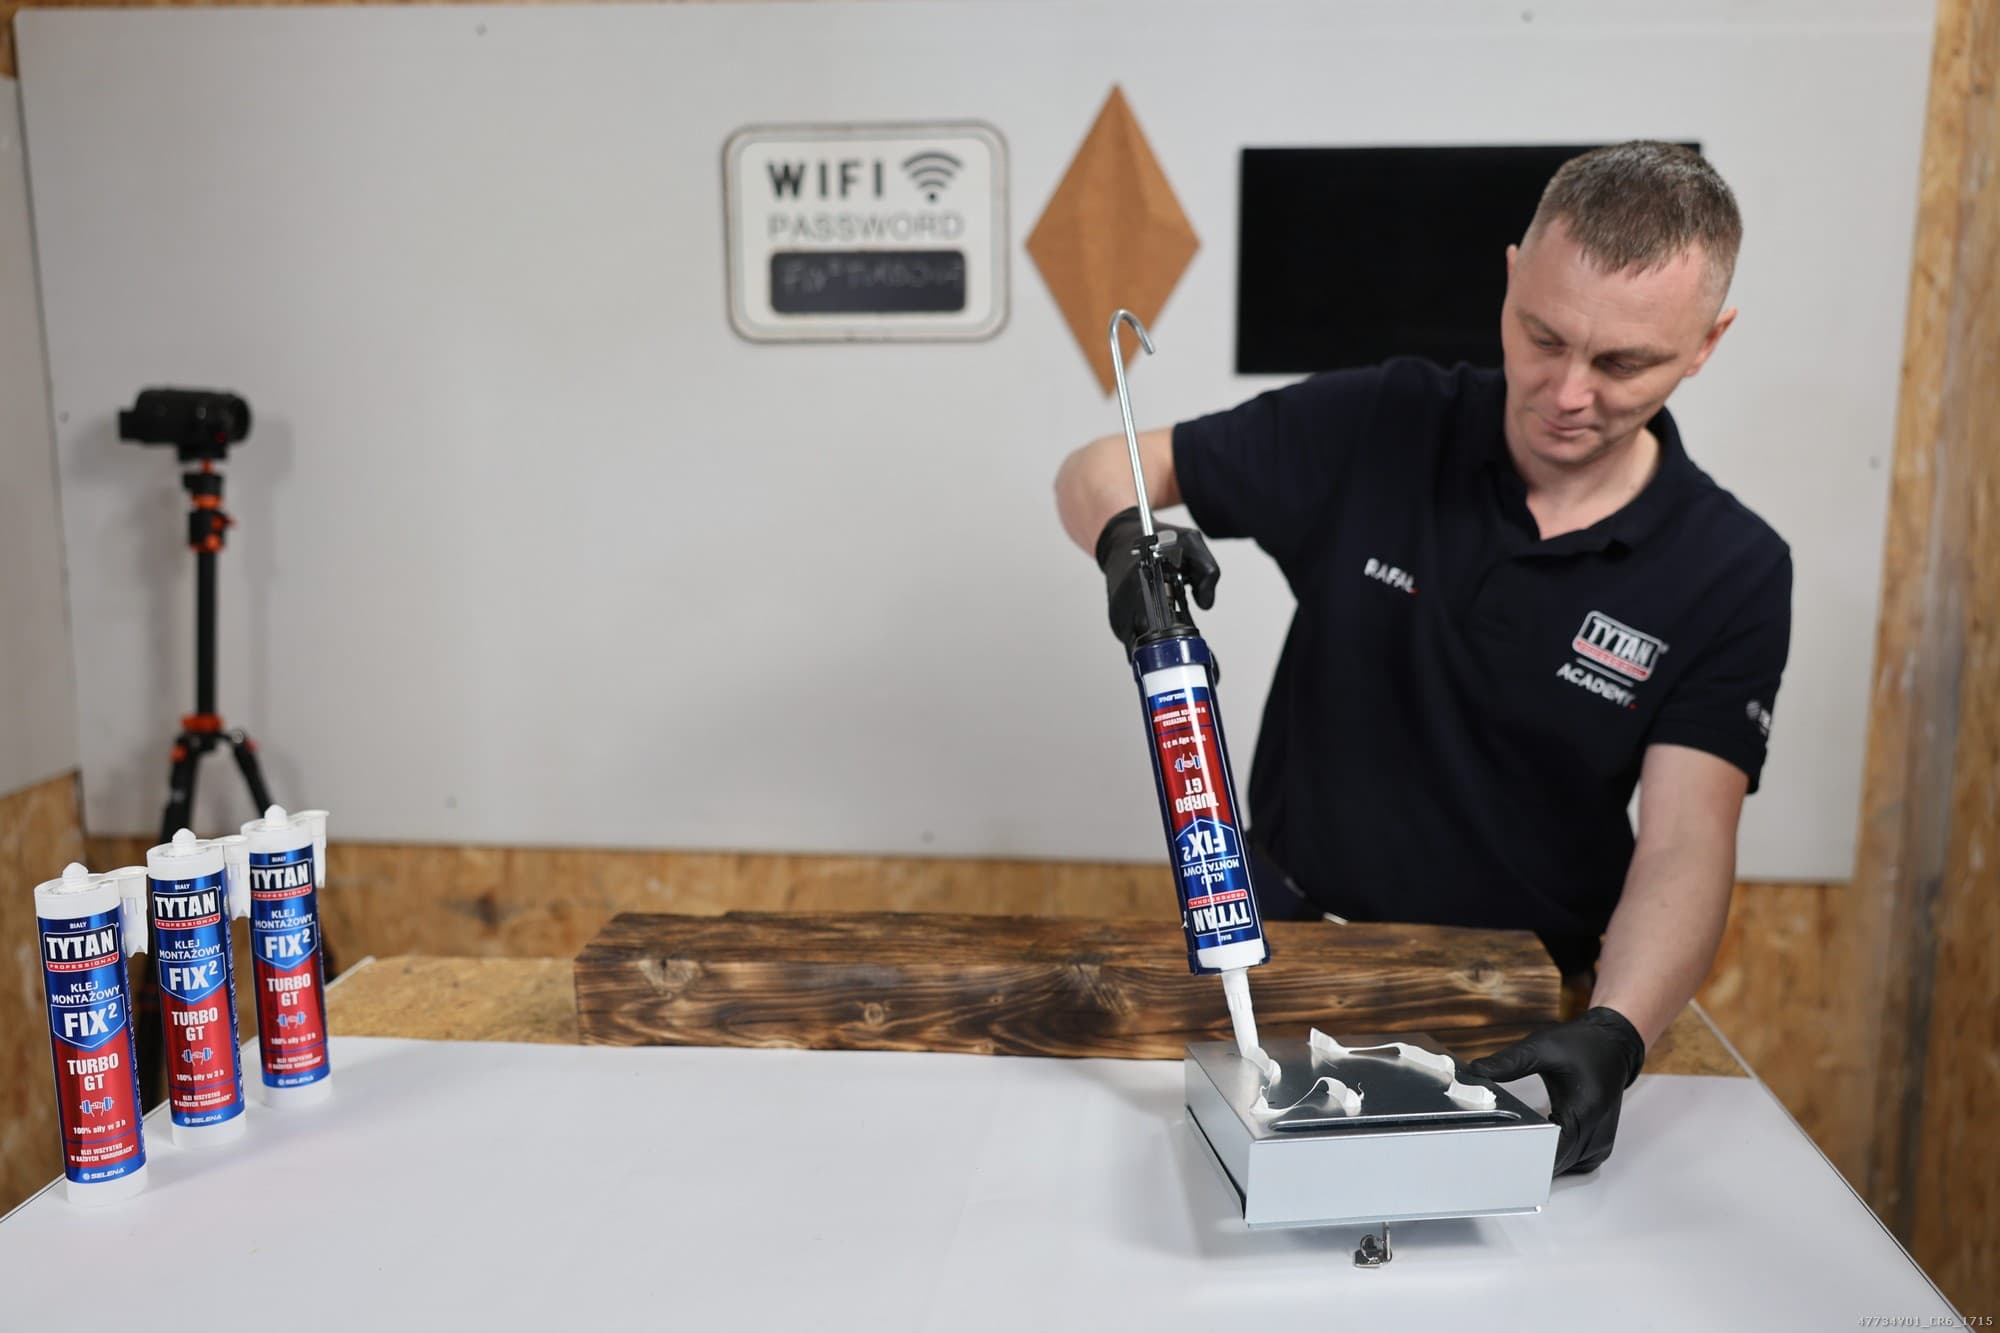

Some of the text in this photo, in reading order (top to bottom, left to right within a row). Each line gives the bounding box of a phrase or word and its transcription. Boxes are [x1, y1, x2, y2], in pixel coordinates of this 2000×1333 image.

[767, 160, 883, 199] WIFI
[768, 210, 966, 240] PASSWORD
[1587, 618, 1655, 667] TYTAN
[1184, 777, 1202, 795] GT
[1175, 791, 1219, 813] TURBO
[251, 863, 309, 890] TYTAN
[155, 892, 216, 918] TYTAN
[271, 908, 296, 919] KLEJ
[1191, 900, 1250, 932] TYTAN
[46, 929, 115, 960] TYTAN
[174, 939, 200, 950] KLEJ
[49, 956, 117, 969] PROFESSIONAL
[70, 980, 99, 993] KLEJ
[266, 973, 311, 992] TURBO
[52, 985, 120, 1004] MONTAŻOWY
[281, 991, 299, 1007] GT
[171, 1007, 218, 1026] TURBO
[186, 1026, 205, 1042] GT
[67, 1053, 119, 1076] TURBO
[84, 1074, 105, 1091] GT
[73, 1127, 91, 1135] 100%
[91, 1168, 125, 1180] SELENA
